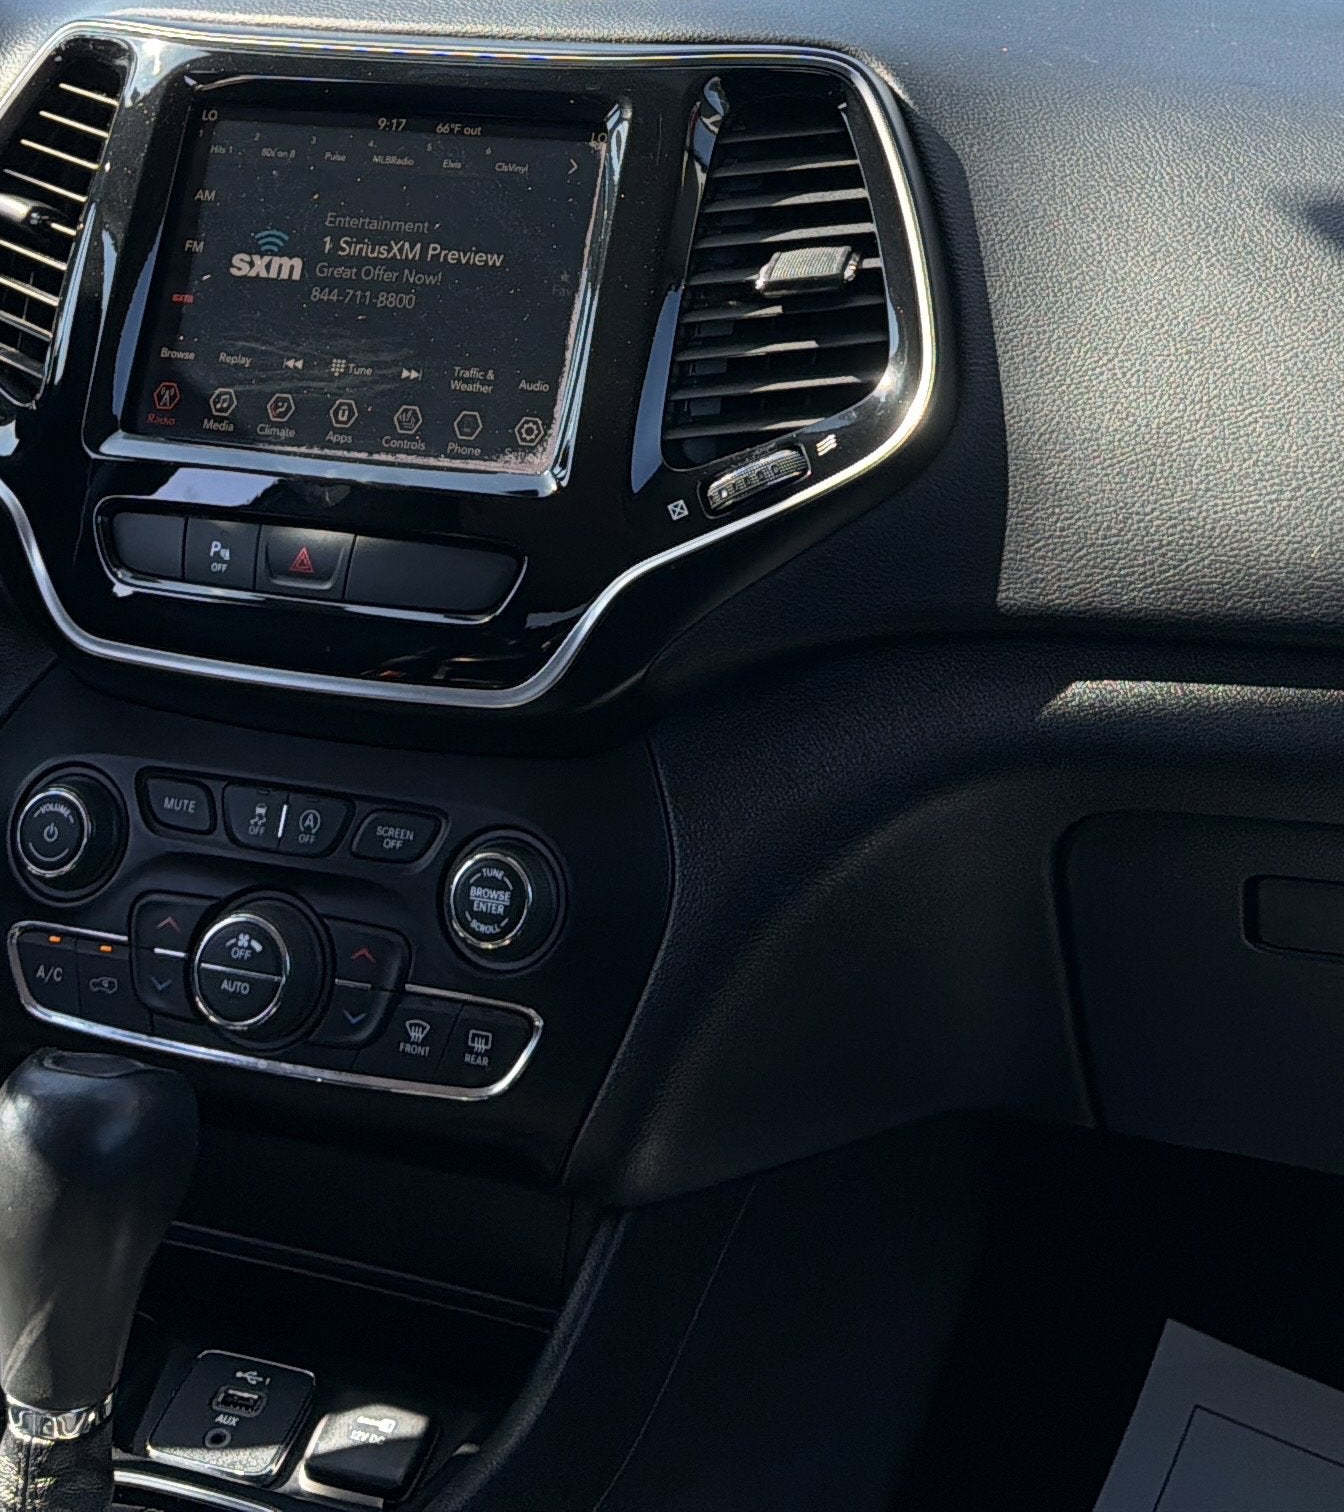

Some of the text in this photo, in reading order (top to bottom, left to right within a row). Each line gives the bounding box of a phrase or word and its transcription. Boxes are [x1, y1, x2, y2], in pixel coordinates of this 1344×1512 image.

[201, 109, 219, 122] LO
[377, 117, 407, 132] 9:17
[435, 121, 461, 136] 66°F
[463, 124, 483, 136] out
[210, 145, 226, 155] Hits
[324, 151, 347, 163] Pulse
[372, 155, 415, 167] MLBRadio
[442, 159, 462, 169] Elvis
[194, 189, 216, 202] AM
[325, 213, 429, 235] Entertainment
[184, 240, 204, 253] FM
[337, 237, 422, 262] SiriusXM
[428, 243, 505, 268] Preview
[229, 252, 304, 281] sxm
[315, 262, 443, 286] Great Offer Now!
[310, 286, 417, 310] 844-711-8800
[159, 346, 550, 394] Browse Replay Tune Traffic & Audio
[450, 378, 494, 395] Weather
[146, 412, 176, 427] Radio
[202, 418, 235, 433] Media
[256, 423, 296, 440] Climate
[325, 430, 354, 447] Apps
[381, 436, 427, 452] Controls
[446, 442, 482, 457] Phone
[210, 562, 229, 574] OFF
[40, 801, 71, 819] VOLUME
[163, 796, 197, 814] MUTE
[248, 825, 317, 845] OFF OFF
[375, 825, 414, 841] SCREEN
[382, 838, 404, 850] OFF
[481, 867, 504, 881] TUNE
[469, 885, 511, 902] BROWSE
[472, 900, 505, 916] ENTER
[469, 918, 501, 935] SCROLL
[231, 946, 253, 961] OFF
[36, 964, 64, 983] A/C
[220, 978, 251, 996] AUTO
[399, 1041, 430, 1058] FRONT
[464, 1053, 489, 1067] REAR
[214, 1413, 240, 1428] AUX
